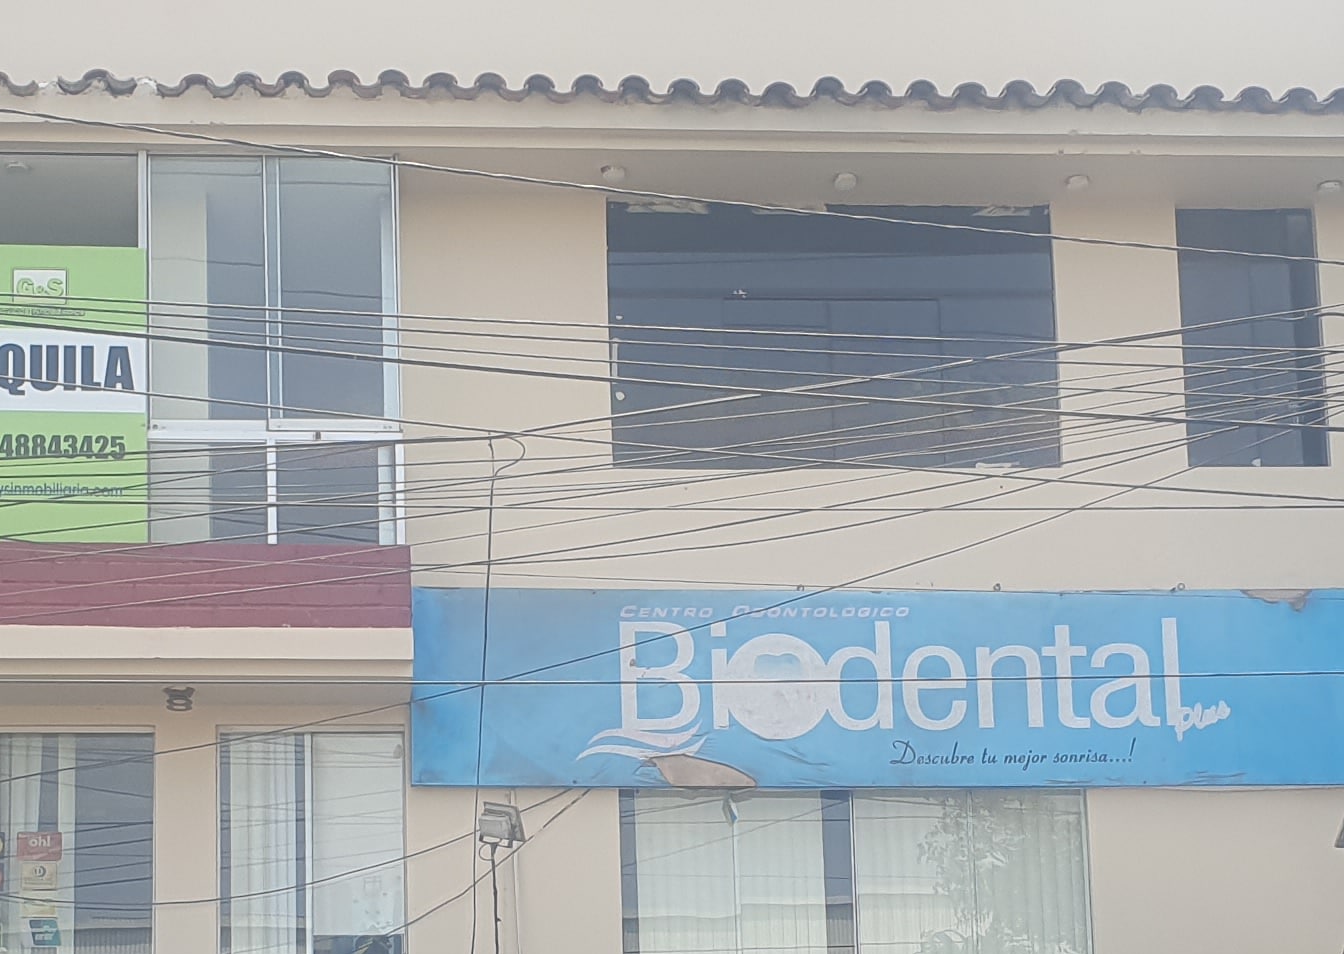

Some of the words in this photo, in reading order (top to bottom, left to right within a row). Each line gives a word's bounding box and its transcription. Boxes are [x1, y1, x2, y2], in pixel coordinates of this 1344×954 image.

[620, 605, 713, 618] CENTRO
[890, 740, 975, 765] Descubre
[981, 747, 998, 764] tu
[1004, 750, 1048, 771] mejor
